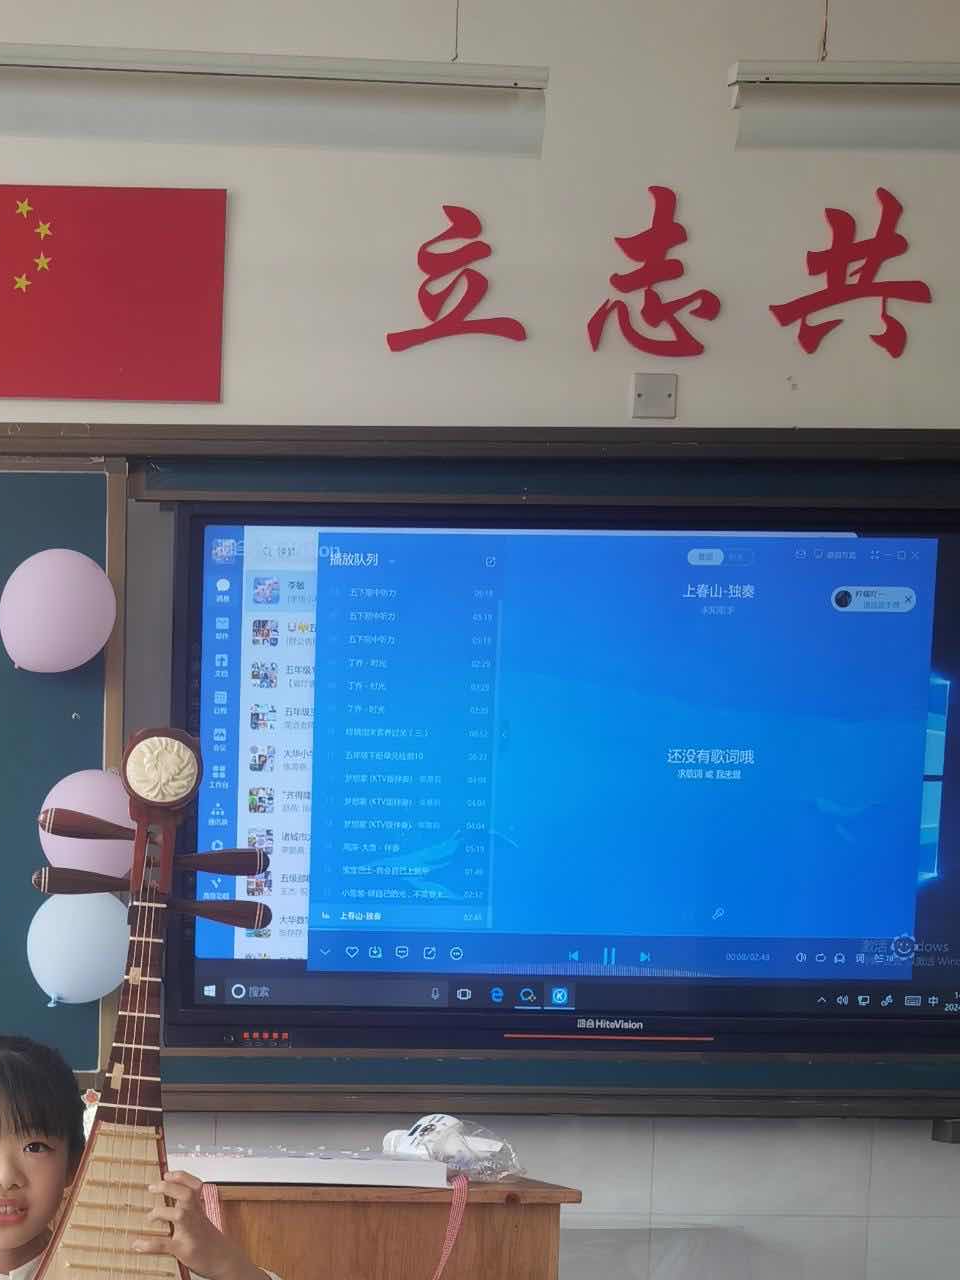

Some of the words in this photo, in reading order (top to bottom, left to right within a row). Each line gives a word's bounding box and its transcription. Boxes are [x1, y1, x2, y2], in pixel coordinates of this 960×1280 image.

[386, 185, 933, 359] 立志共
[330, 552, 378, 567] 播放队列
[683, 583, 755, 599] 上春山-独奏
[667, 747, 755, 764] 还没有歌词哦
[596, 1018, 644, 1030] HiteVision
